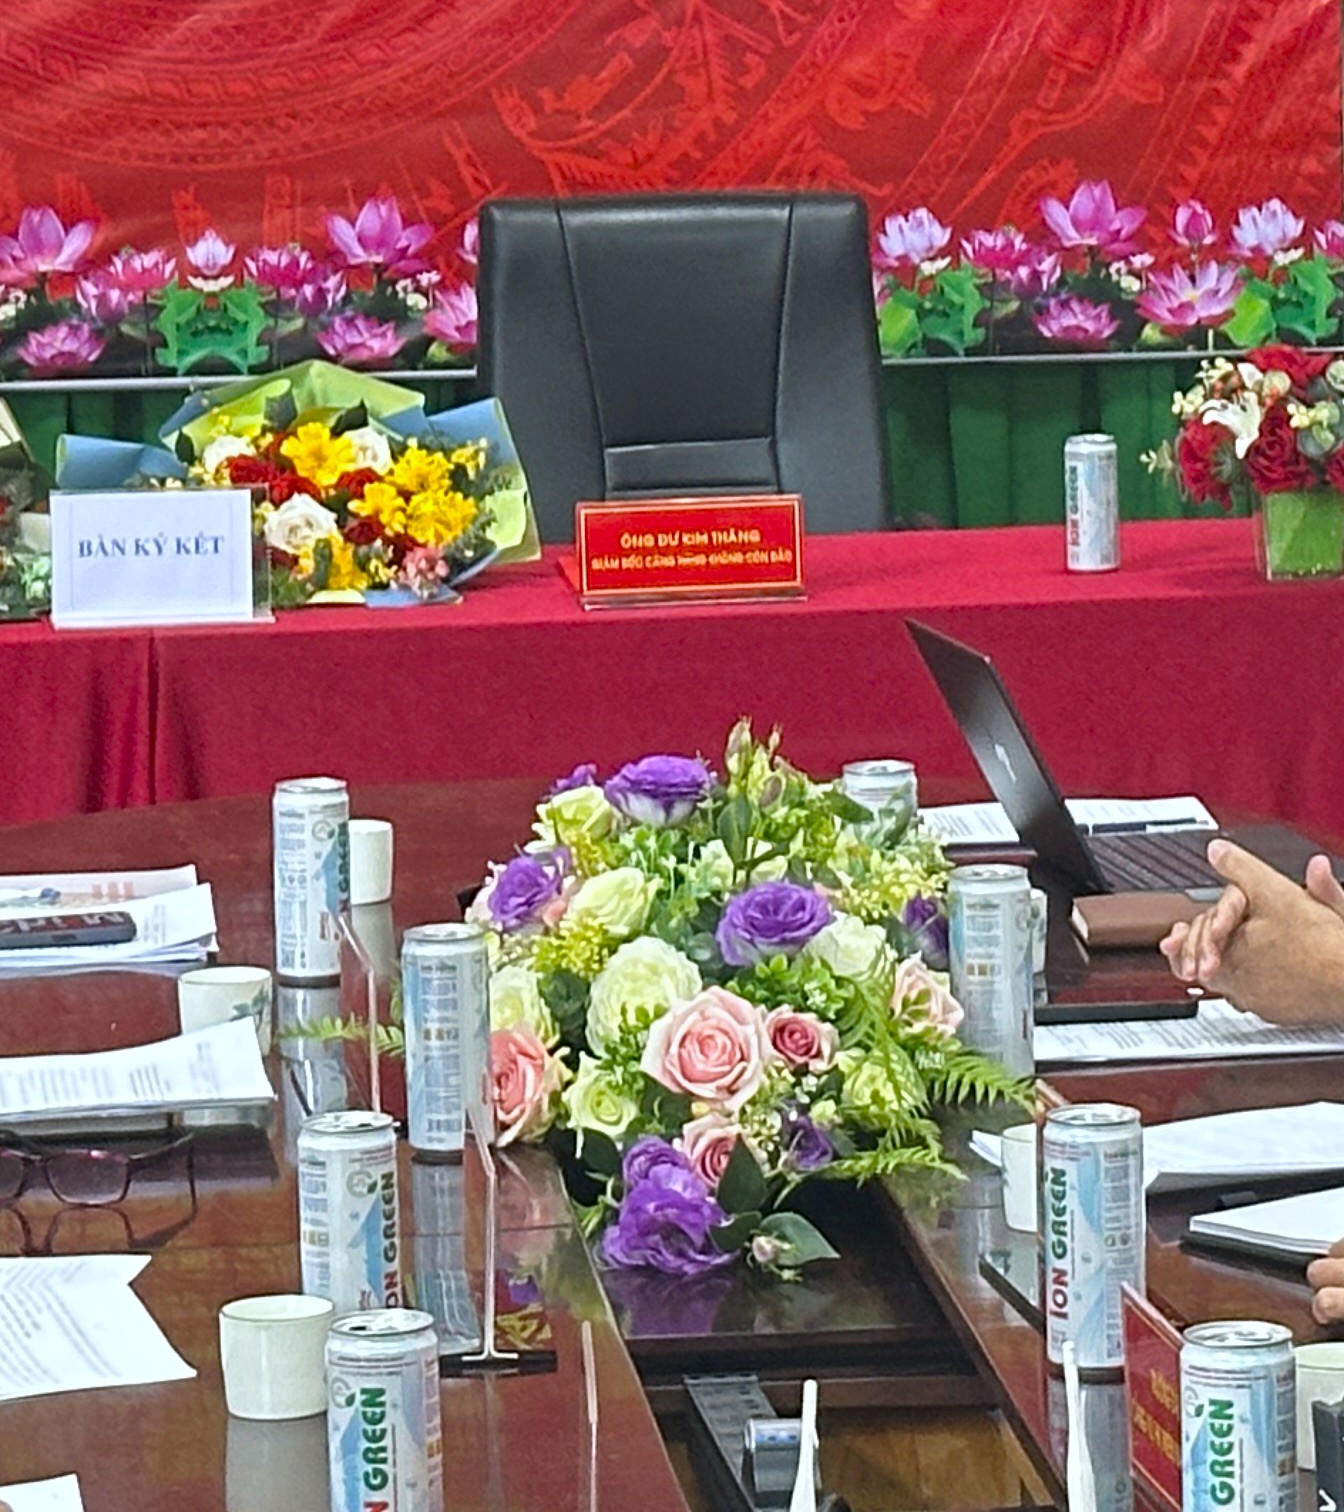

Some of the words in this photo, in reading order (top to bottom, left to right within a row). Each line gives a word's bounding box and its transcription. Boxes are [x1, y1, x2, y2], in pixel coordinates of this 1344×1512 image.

[134, 531, 167, 556] KÝ
[175, 530, 224, 555] KẾT
[380, 1170, 398, 1264] GREEN
[1049, 1267, 1069, 1321] ION
[360, 1387, 389, 1491] GREEN
[1208, 1398, 1236, 1506] GREEN
